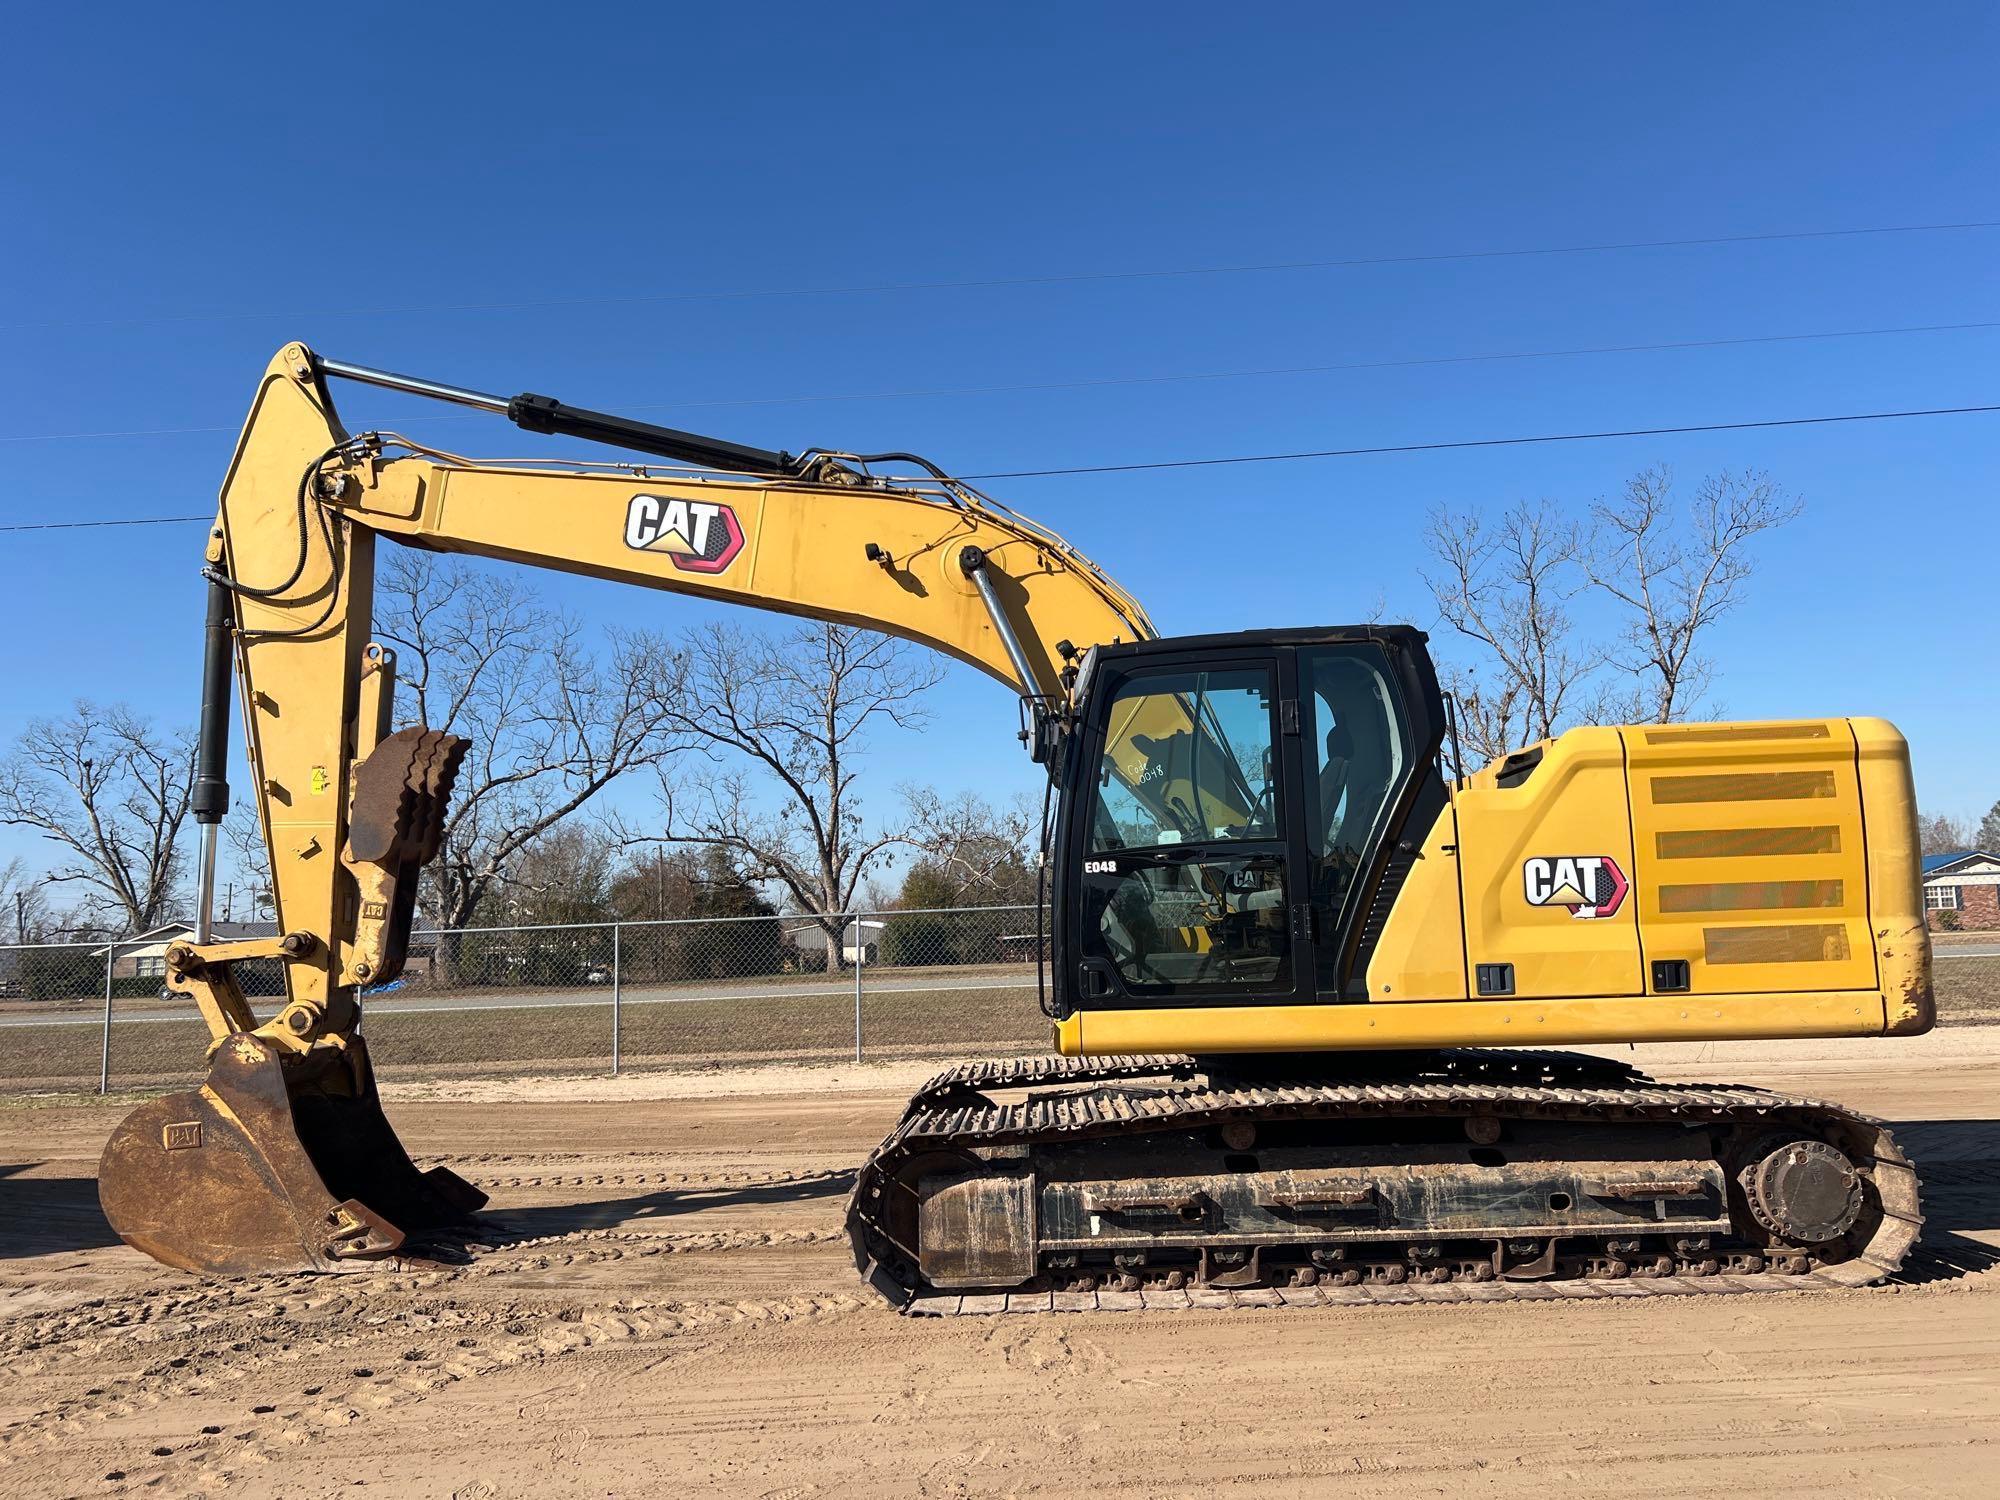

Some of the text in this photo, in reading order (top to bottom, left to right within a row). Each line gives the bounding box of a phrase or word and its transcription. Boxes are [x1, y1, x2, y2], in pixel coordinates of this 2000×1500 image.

[626, 496, 720, 556] CAT
[1139, 764, 1164, 784] 0048
[1084, 861, 1117, 874] E048
[1233, 870, 1263, 888] CAT
[1524, 858, 1602, 905] CAT
